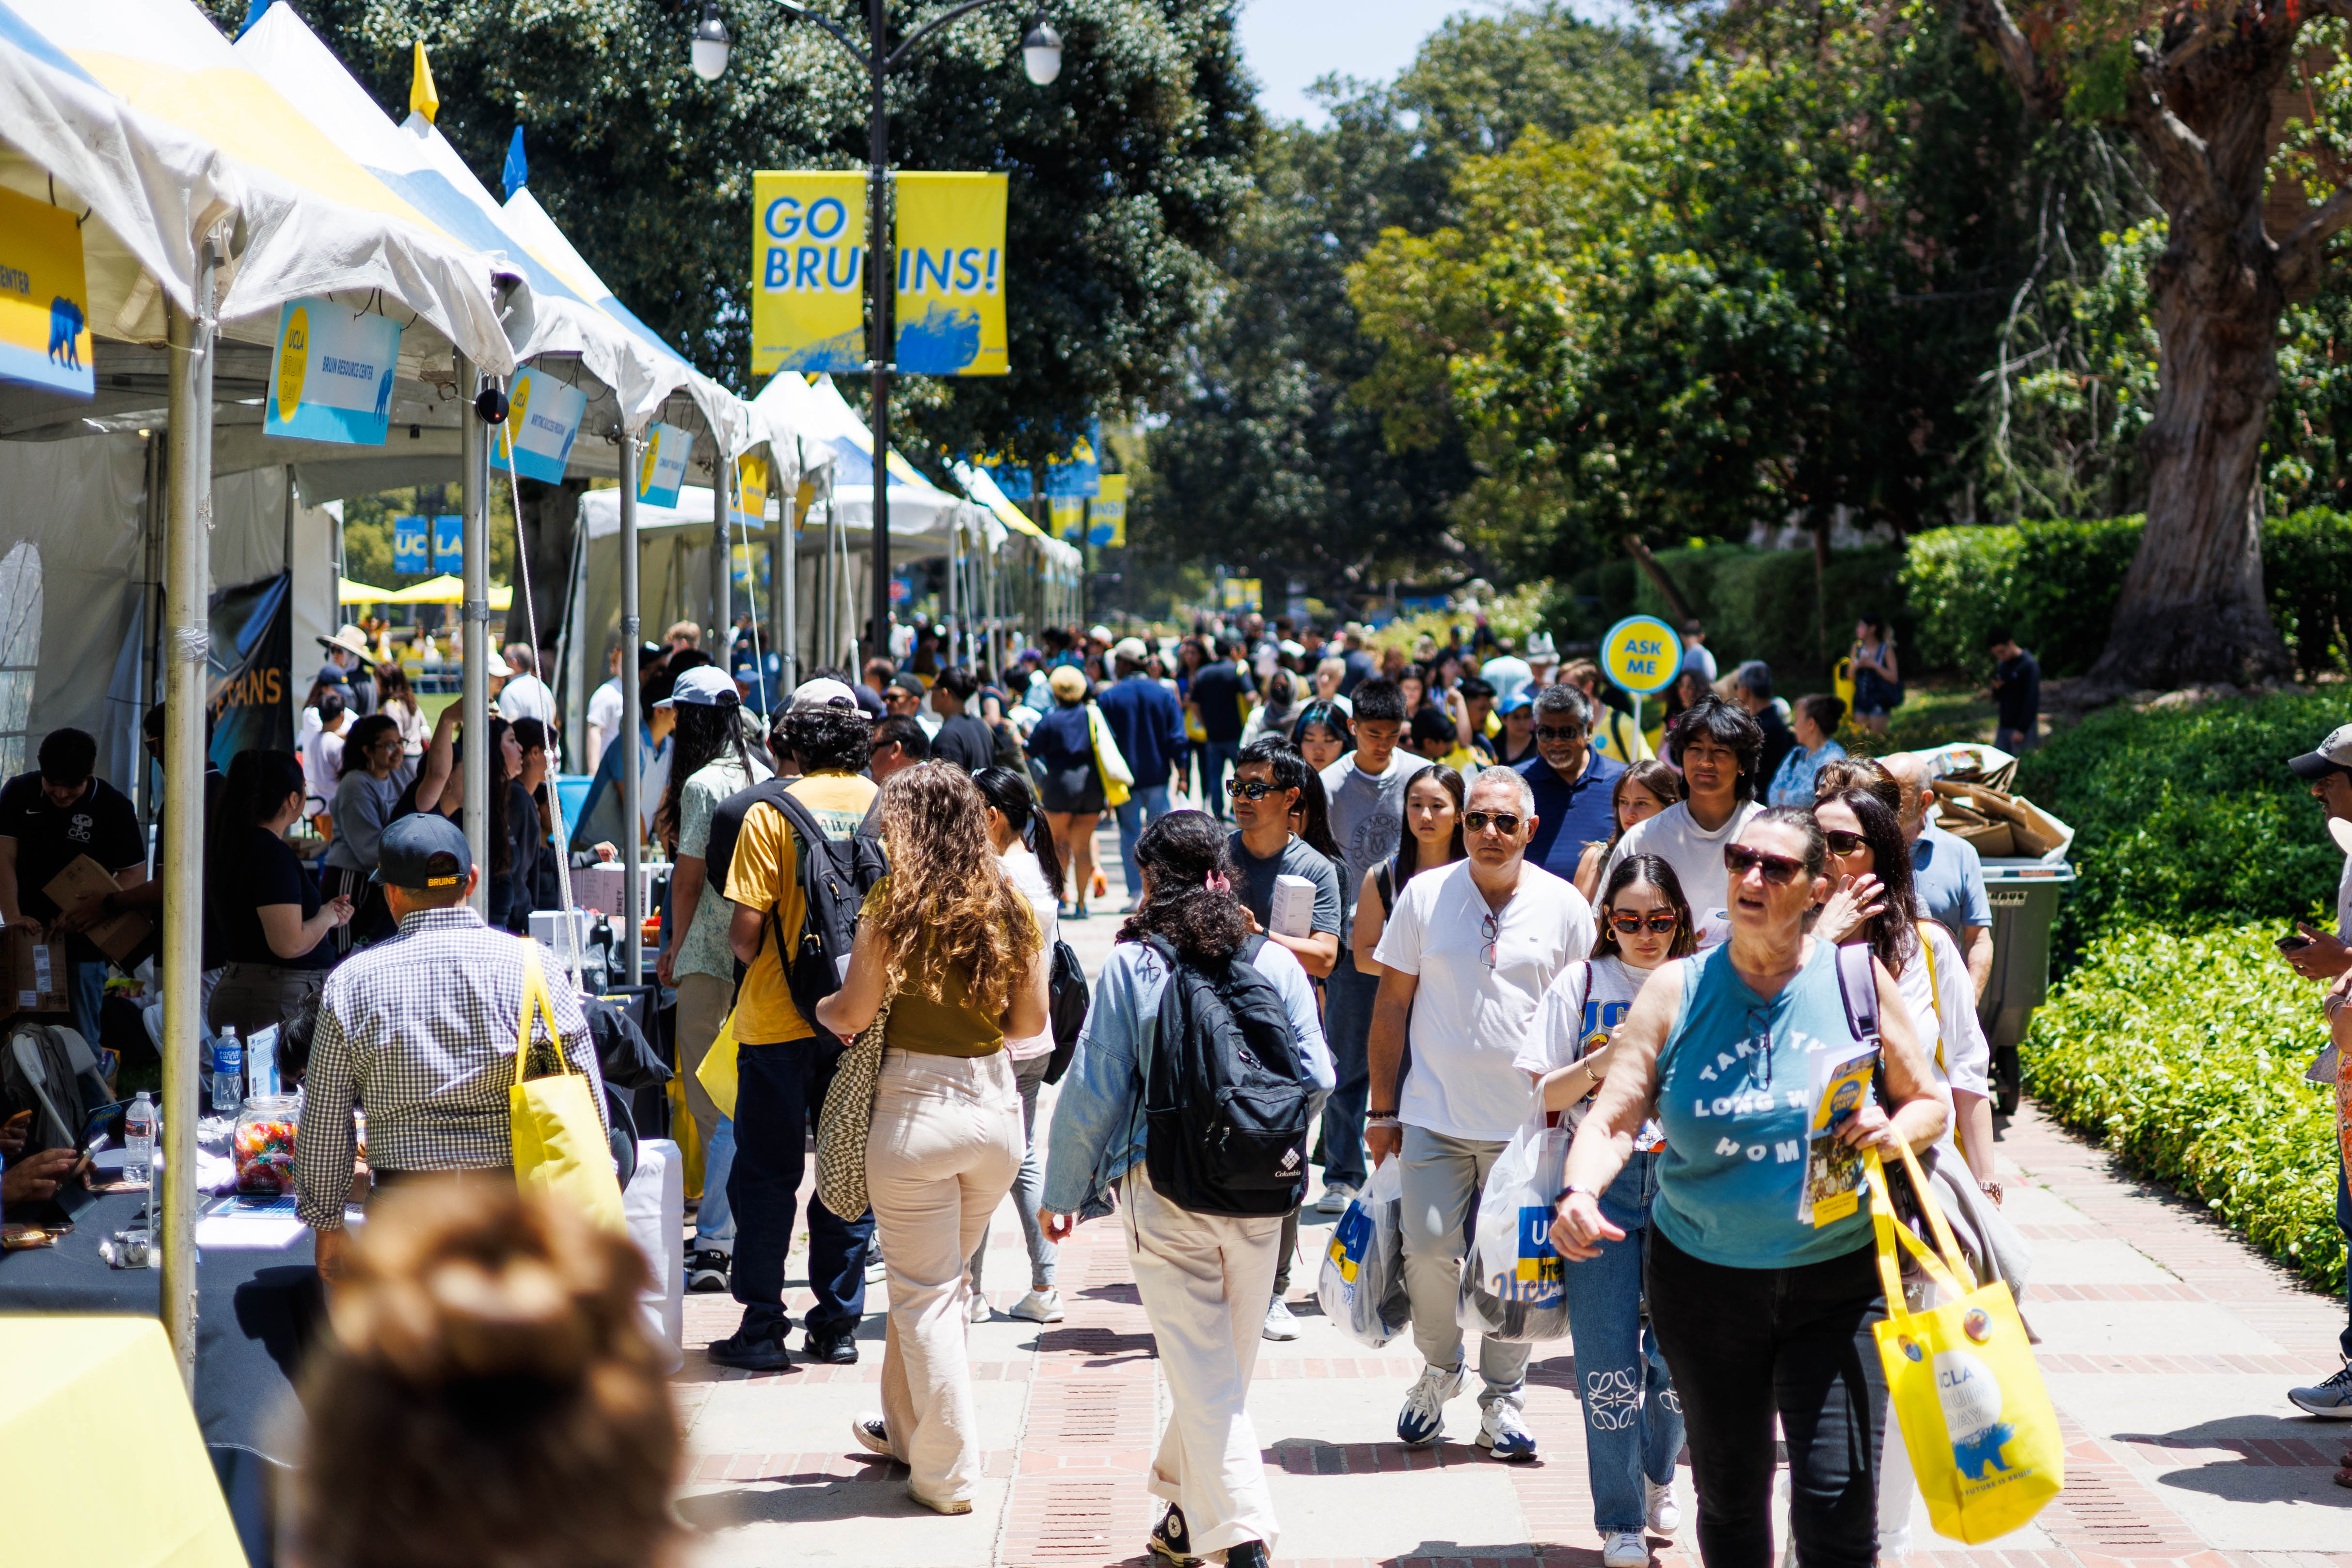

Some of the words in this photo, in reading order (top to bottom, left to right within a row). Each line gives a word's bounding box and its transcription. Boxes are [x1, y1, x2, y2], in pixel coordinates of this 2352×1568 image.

[764, 197, 849, 244] GO
[764, 247, 863, 294] BRU
[898, 248, 1000, 295] INS!
[288, 329, 304, 350] UCLA
[322, 356, 338, 373] BRUIN
[337, 359, 359, 378] RESOURCE
[359, 363, 373, 380] CENTER
[1624, 639, 1663, 656] ASK
[1626, 659, 1656, 675] ME
[68, 828, 91, 840] CPO
[1353, 826, 1367, 859] CLUB
[428, 877, 457, 887] BRUINS
[1699, 1033, 1774, 1082] TAKE
[1791, 1030, 1827, 1054] TH
[1695, 1094, 1775, 1118] LONG
[1786, 1089, 1810, 1109] W
[1715, 1136, 1803, 1164] HOM
[1274, 1170, 1302, 1178] Columbia
[1541, 1264, 1563, 1276] STO
[1966, 1481, 1996, 1496] FUTURE
[2008, 1468, 2033, 1482] BRUIN
